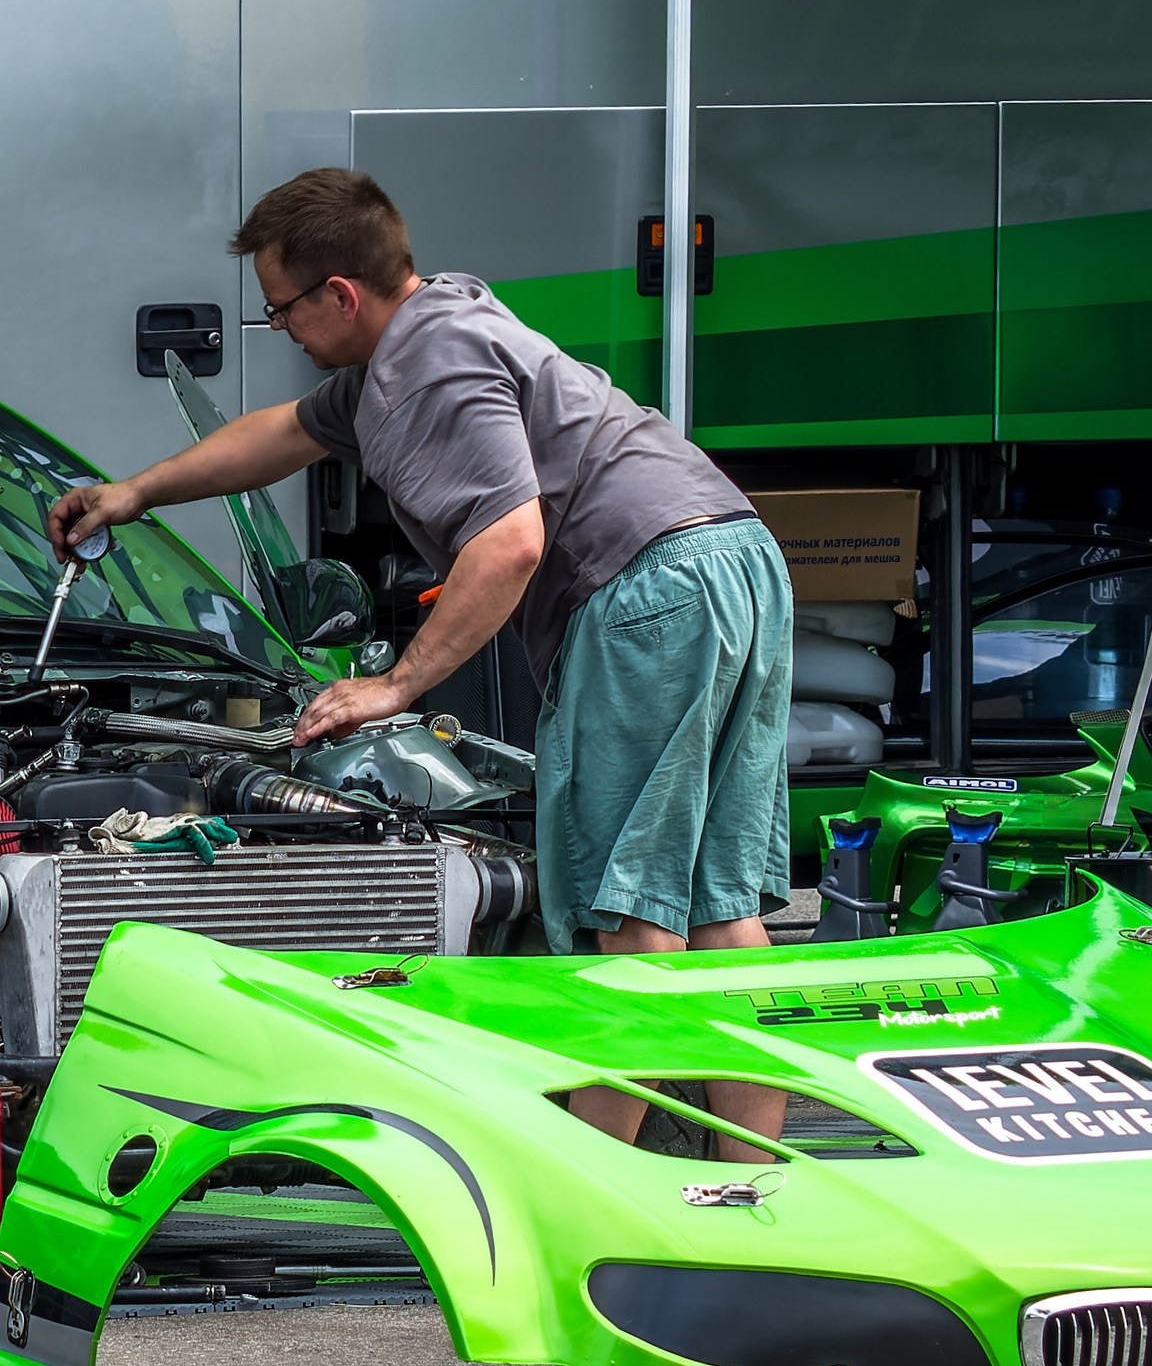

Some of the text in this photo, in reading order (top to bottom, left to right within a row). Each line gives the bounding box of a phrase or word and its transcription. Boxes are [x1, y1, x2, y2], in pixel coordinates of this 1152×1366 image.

[779, 537, 901, 550] очных материалов
[841, 555, 861, 566] для
[864, 555, 901, 563] мешка
[928, 778, 1012, 789] AIMOL
[724, 976, 999, 1008] TEAM
[757, 999, 949, 1026] 234
[878, 1006, 1001, 1028] Motorsport
[910, 1060, 1152, 1112] LEVEL
